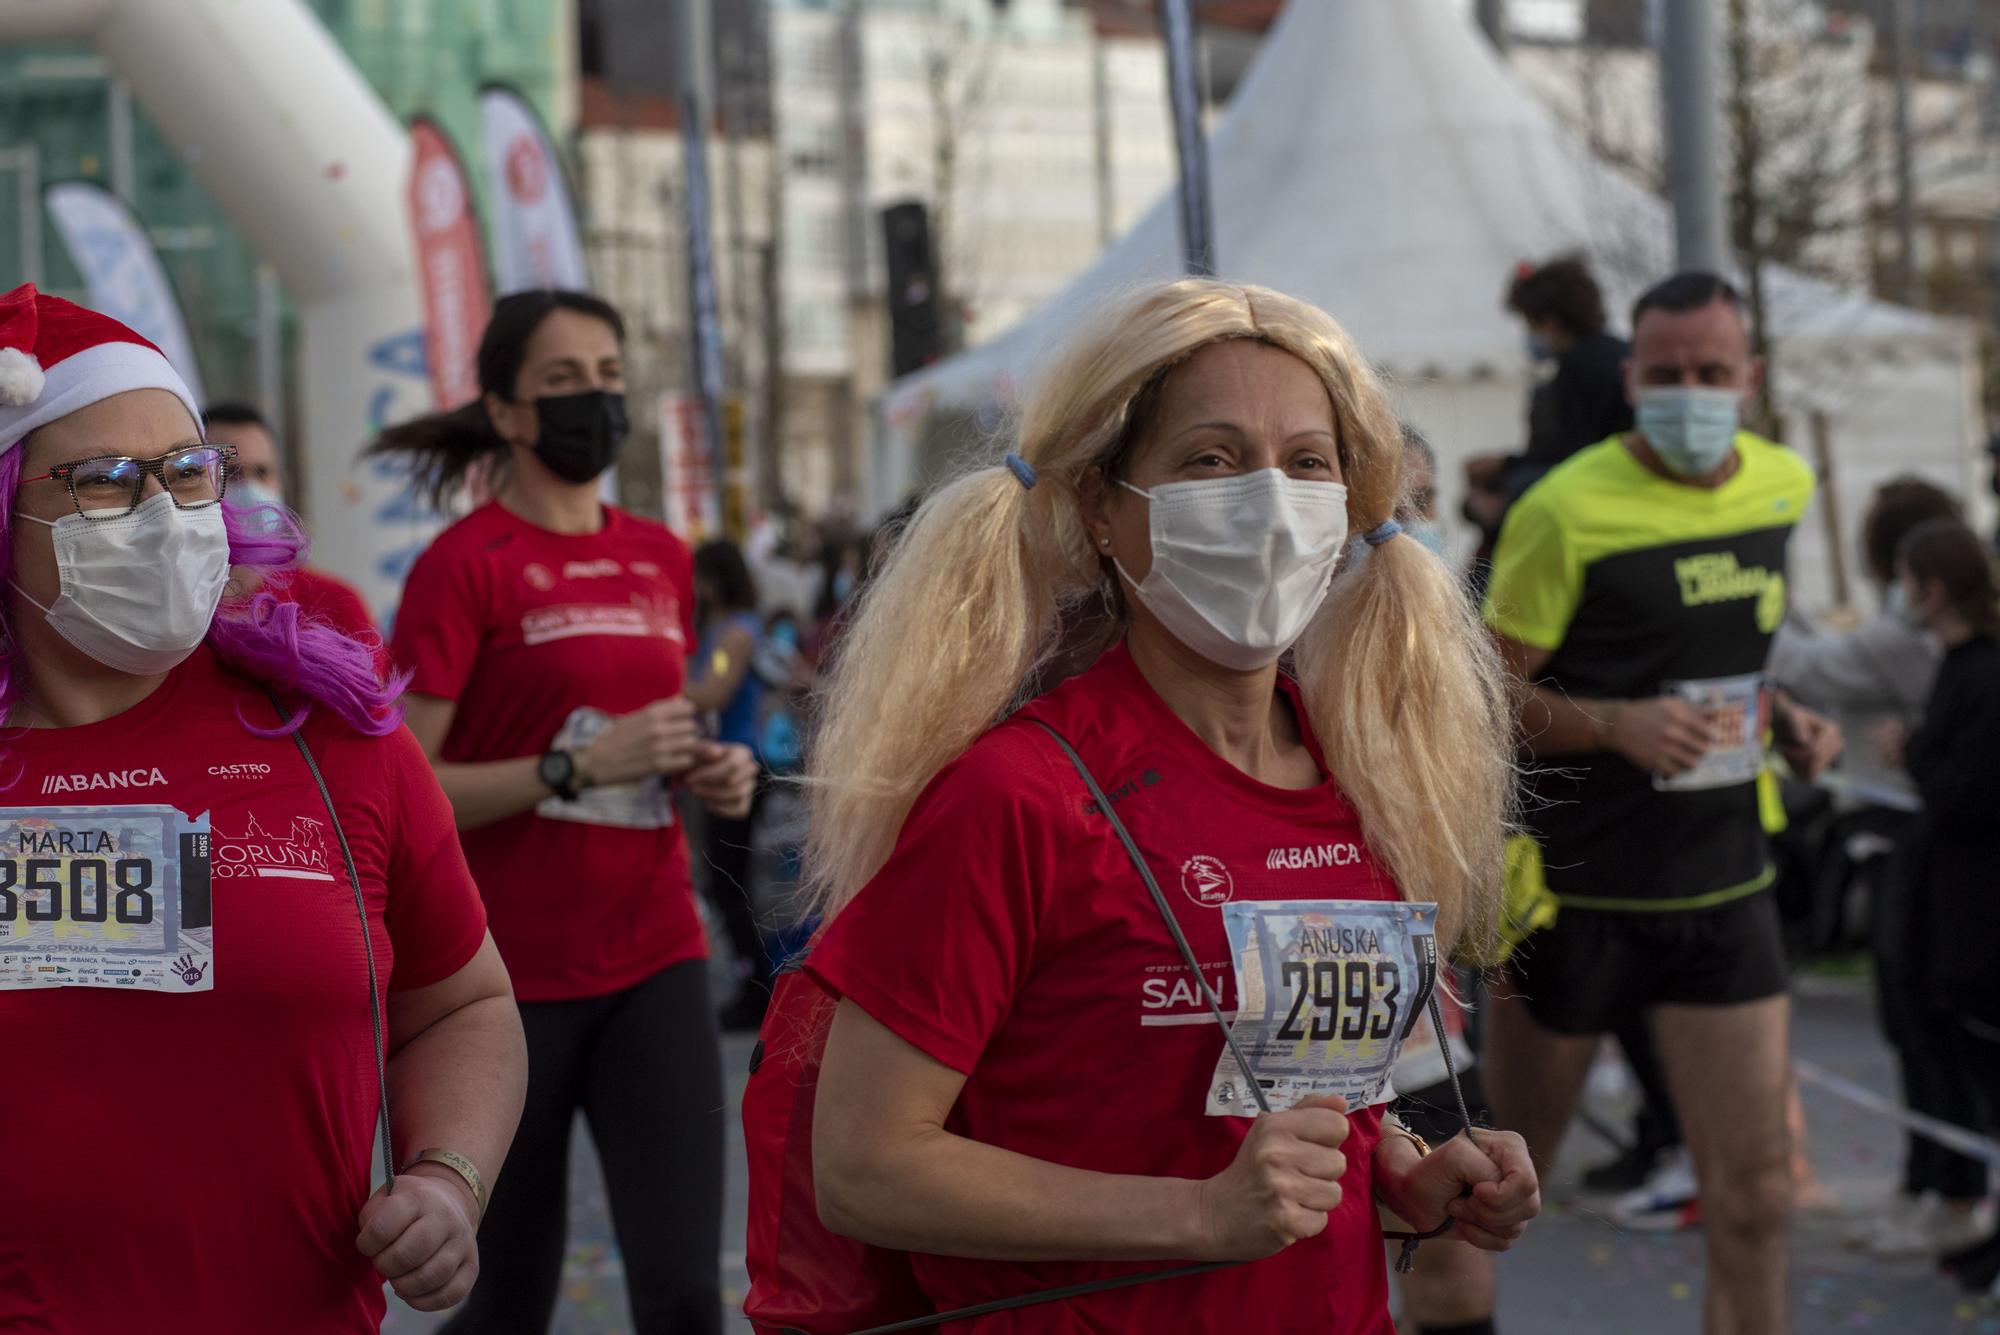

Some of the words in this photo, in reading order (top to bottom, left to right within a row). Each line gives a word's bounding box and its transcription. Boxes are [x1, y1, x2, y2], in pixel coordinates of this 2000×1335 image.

[207, 763, 271, 776] CASTRO
[20, 831, 114, 854] MARIA
[199, 834, 208, 858] 3508
[1300, 929, 1381, 954] ANUSKA
[183, 971, 199, 981] 016
[1142, 975, 1224, 1009] SAN
[1276, 960, 1401, 1042] 2993
